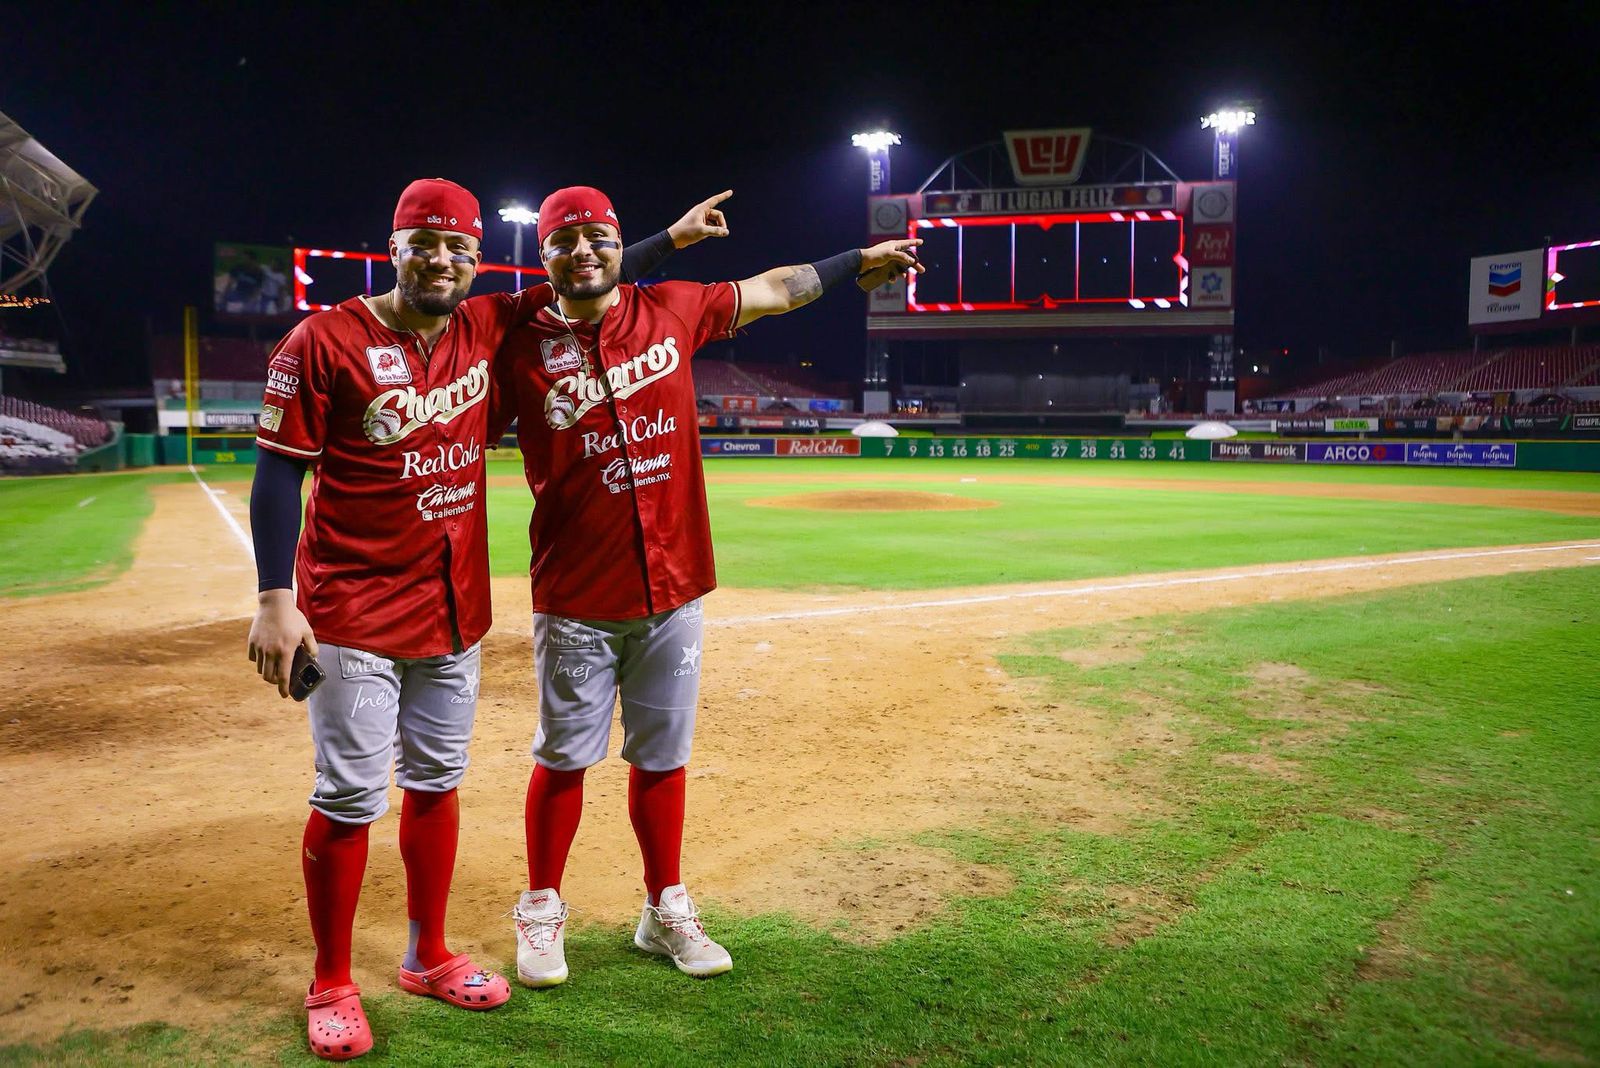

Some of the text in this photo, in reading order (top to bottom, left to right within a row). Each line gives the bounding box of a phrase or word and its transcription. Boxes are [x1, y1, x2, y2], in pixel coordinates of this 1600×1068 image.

[870, 159, 881, 191] TECATE
[981, 188, 1115, 212] MI LUGAR FELIZ
[1489, 262, 1522, 271] Chevron
[544, 337, 680, 431] Charros
[363, 360, 489, 446] Charros
[581, 409, 678, 459] Red Cola
[723, 441, 761, 452] Chevron
[788, 440, 844, 455] Red Cola
[884, 445, 1016, 457] 7 9 13 16 18 25
[1051, 446, 1185, 460] 27 28 31 33 41
[1219, 444, 1297, 457] Bruck Bruck
[1323, 446, 1370, 462] ARCO
[400, 436, 480, 480] Red Cola
[1413, 450, 1509, 461] Dolphy Dolphy Dolphy
[550, 633, 590, 647] MEGA
[347, 660, 394, 674] MEGA
[551, 655, 593, 684] Inés
[351, 686, 392, 718] Inés
